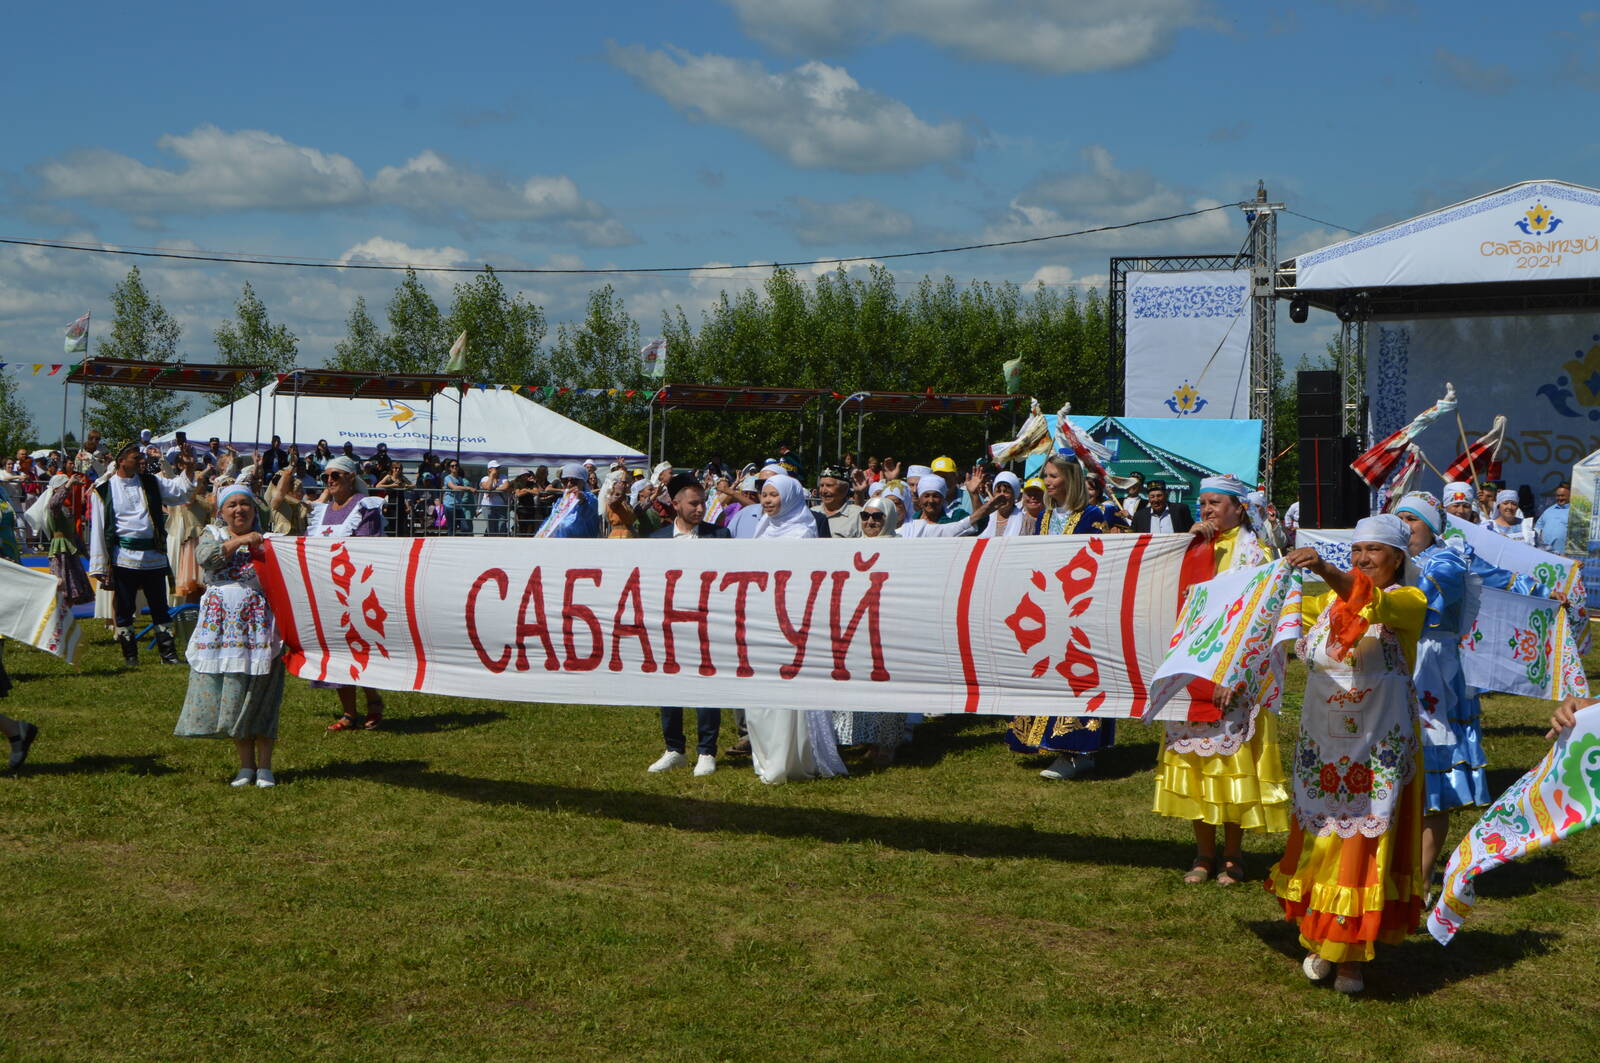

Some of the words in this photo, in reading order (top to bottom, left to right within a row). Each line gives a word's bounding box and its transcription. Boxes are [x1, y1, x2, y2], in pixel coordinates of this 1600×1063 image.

[1480, 235, 1598, 256] Сабантуй
[1515, 255, 1562, 269] 2024
[338, 430, 487, 443] РЫБНО-СЛОБОДСКИЙ
[465, 551, 890, 682] САБАНТУЙ
